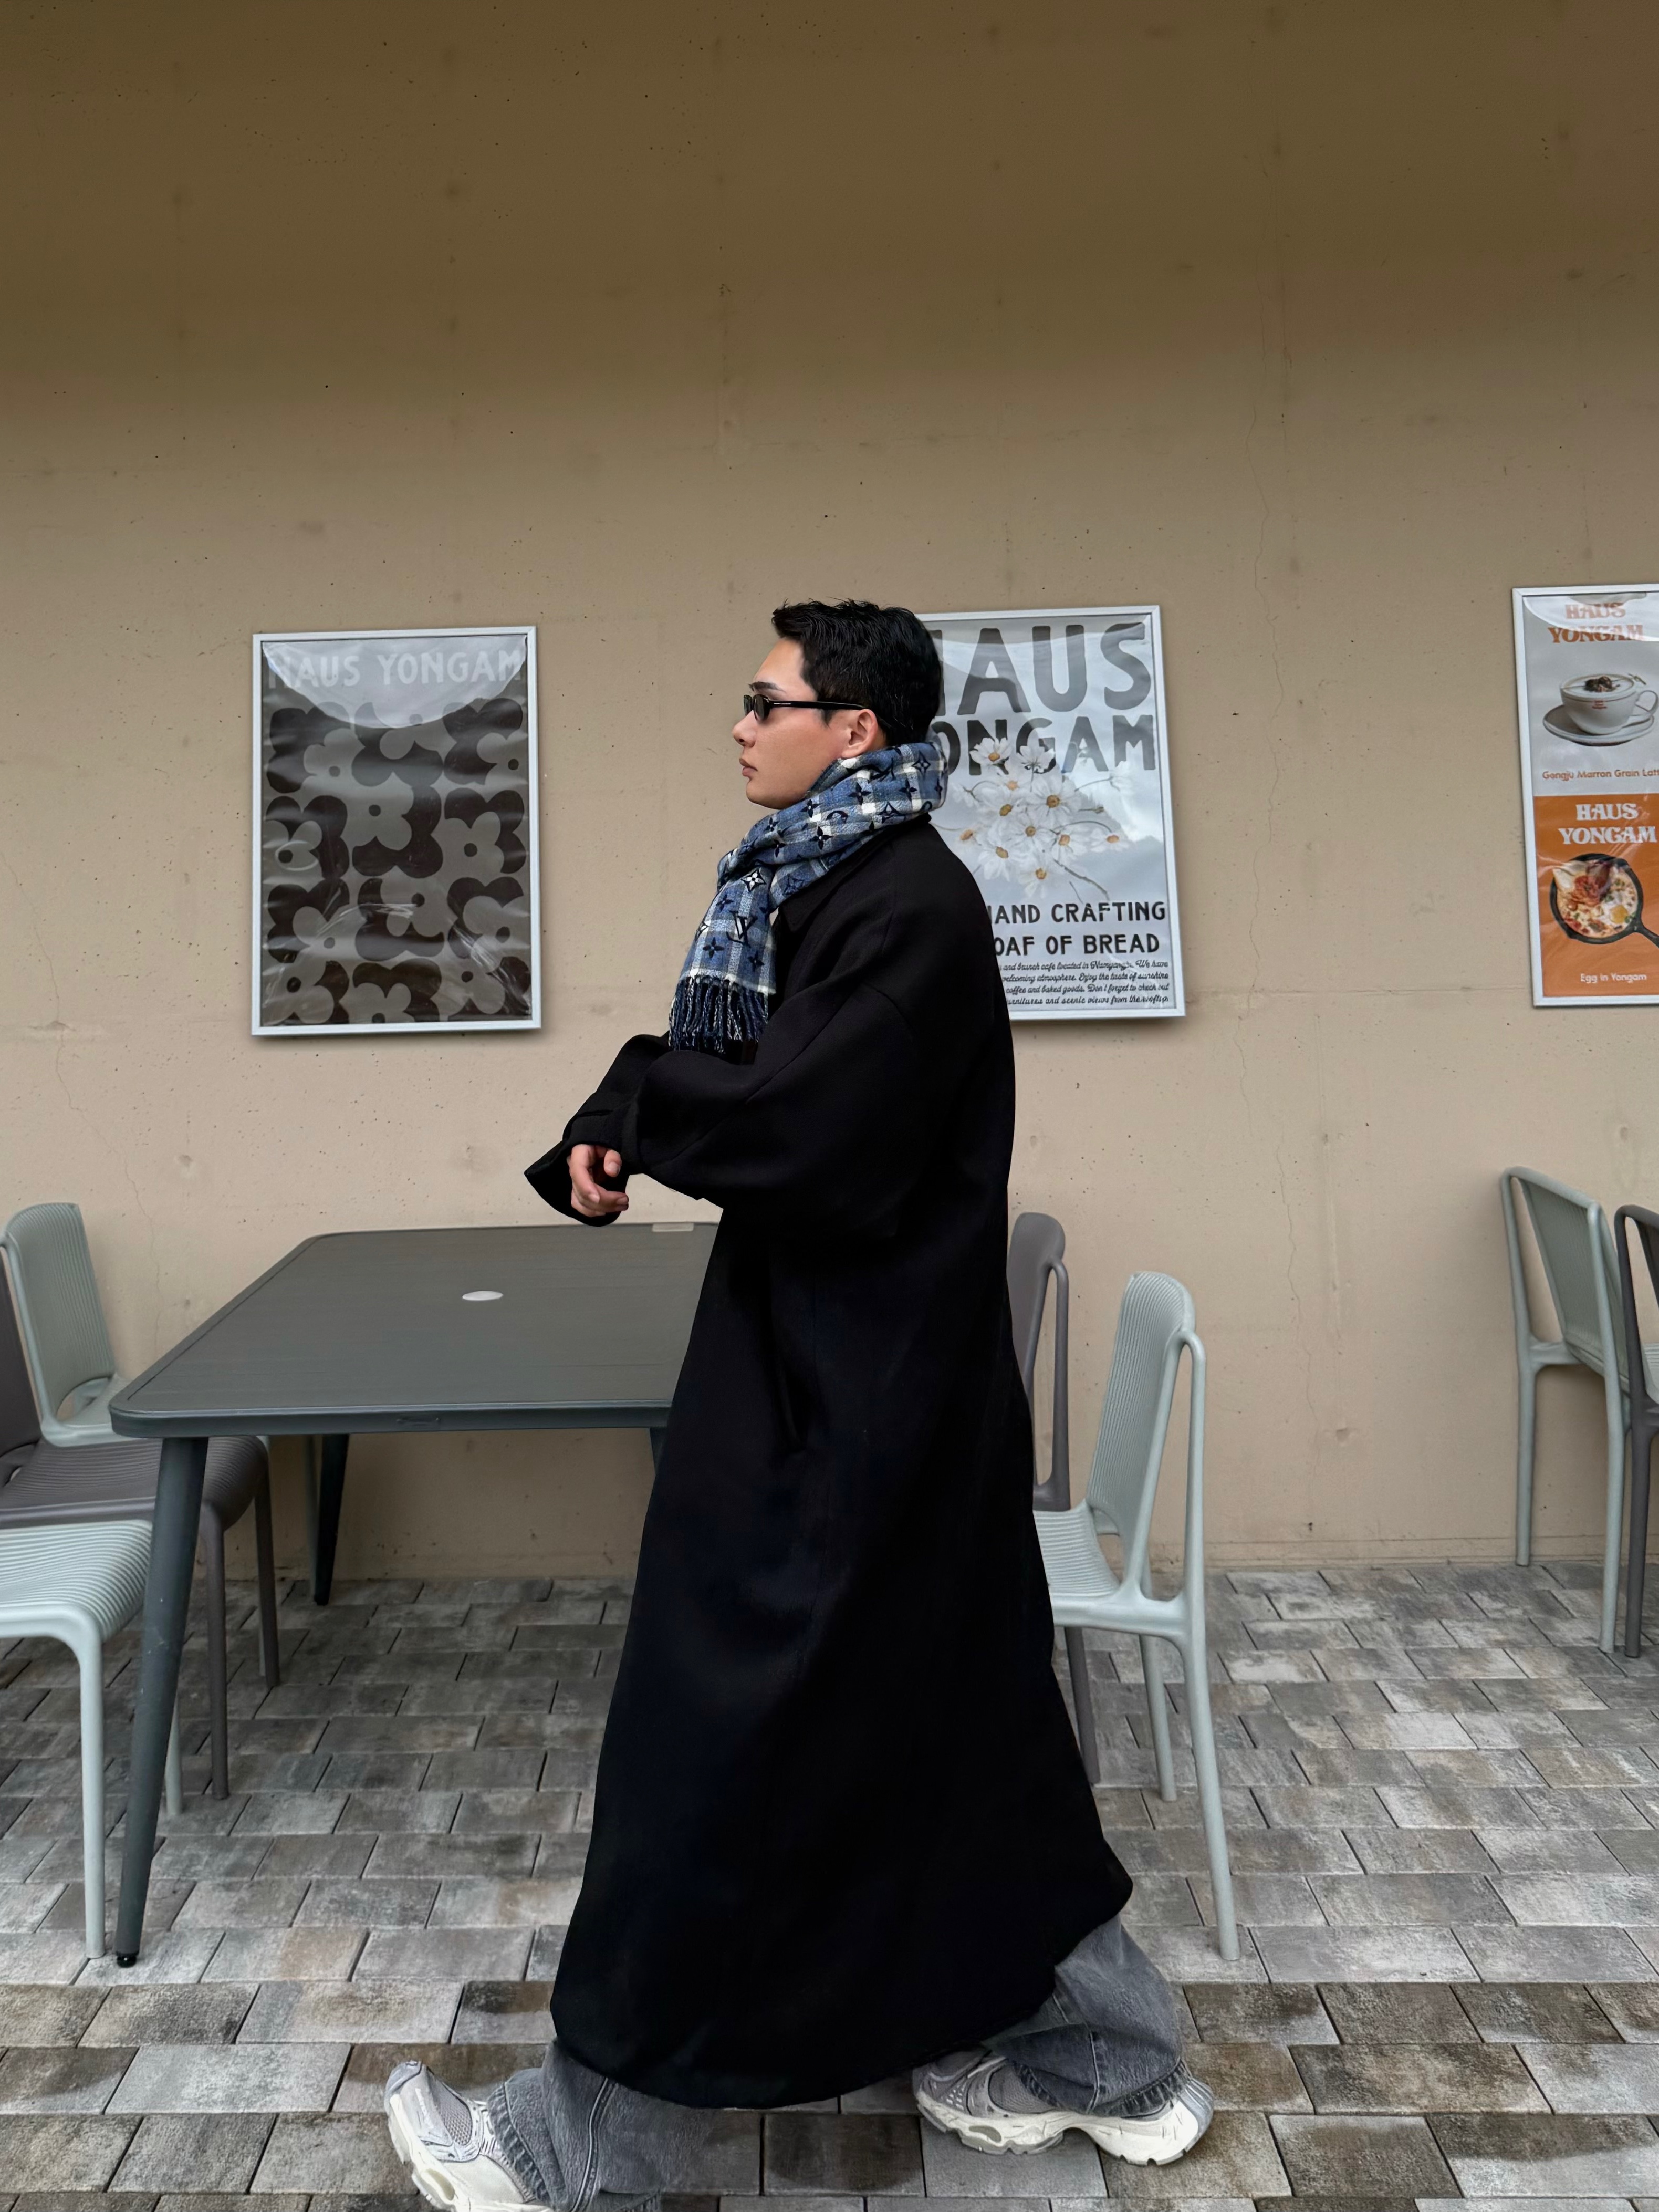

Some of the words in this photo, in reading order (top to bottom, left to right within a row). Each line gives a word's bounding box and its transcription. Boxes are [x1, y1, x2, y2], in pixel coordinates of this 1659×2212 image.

[1566, 603, 1625, 619] HAUS
[1548, 624, 1643, 643] YONGAM
[377, 649, 521, 686] YONGAM
[932, 622, 1151, 716] AUS
[931, 714, 1155, 775] ONGAM
[1614, 769, 1639, 777] Grain
[1576, 803, 1639, 821] HAUS
[1558, 826, 1657, 844] YONGAM
[1051, 901, 1165, 923] CRAFTING
[994, 936, 1035, 956] OAF
[1046, 935, 1072, 955] OF
[1083, 933, 1160, 954] BREAD
[1129, 972, 1137, 982] of
[1580, 973, 1598, 984] Egg
[1611, 973, 1647, 984] Yongam
[1041, 984, 1062, 993] baked
[1061, 996, 1086, 1004] scenic
[1110, 995, 1127, 1005] from
